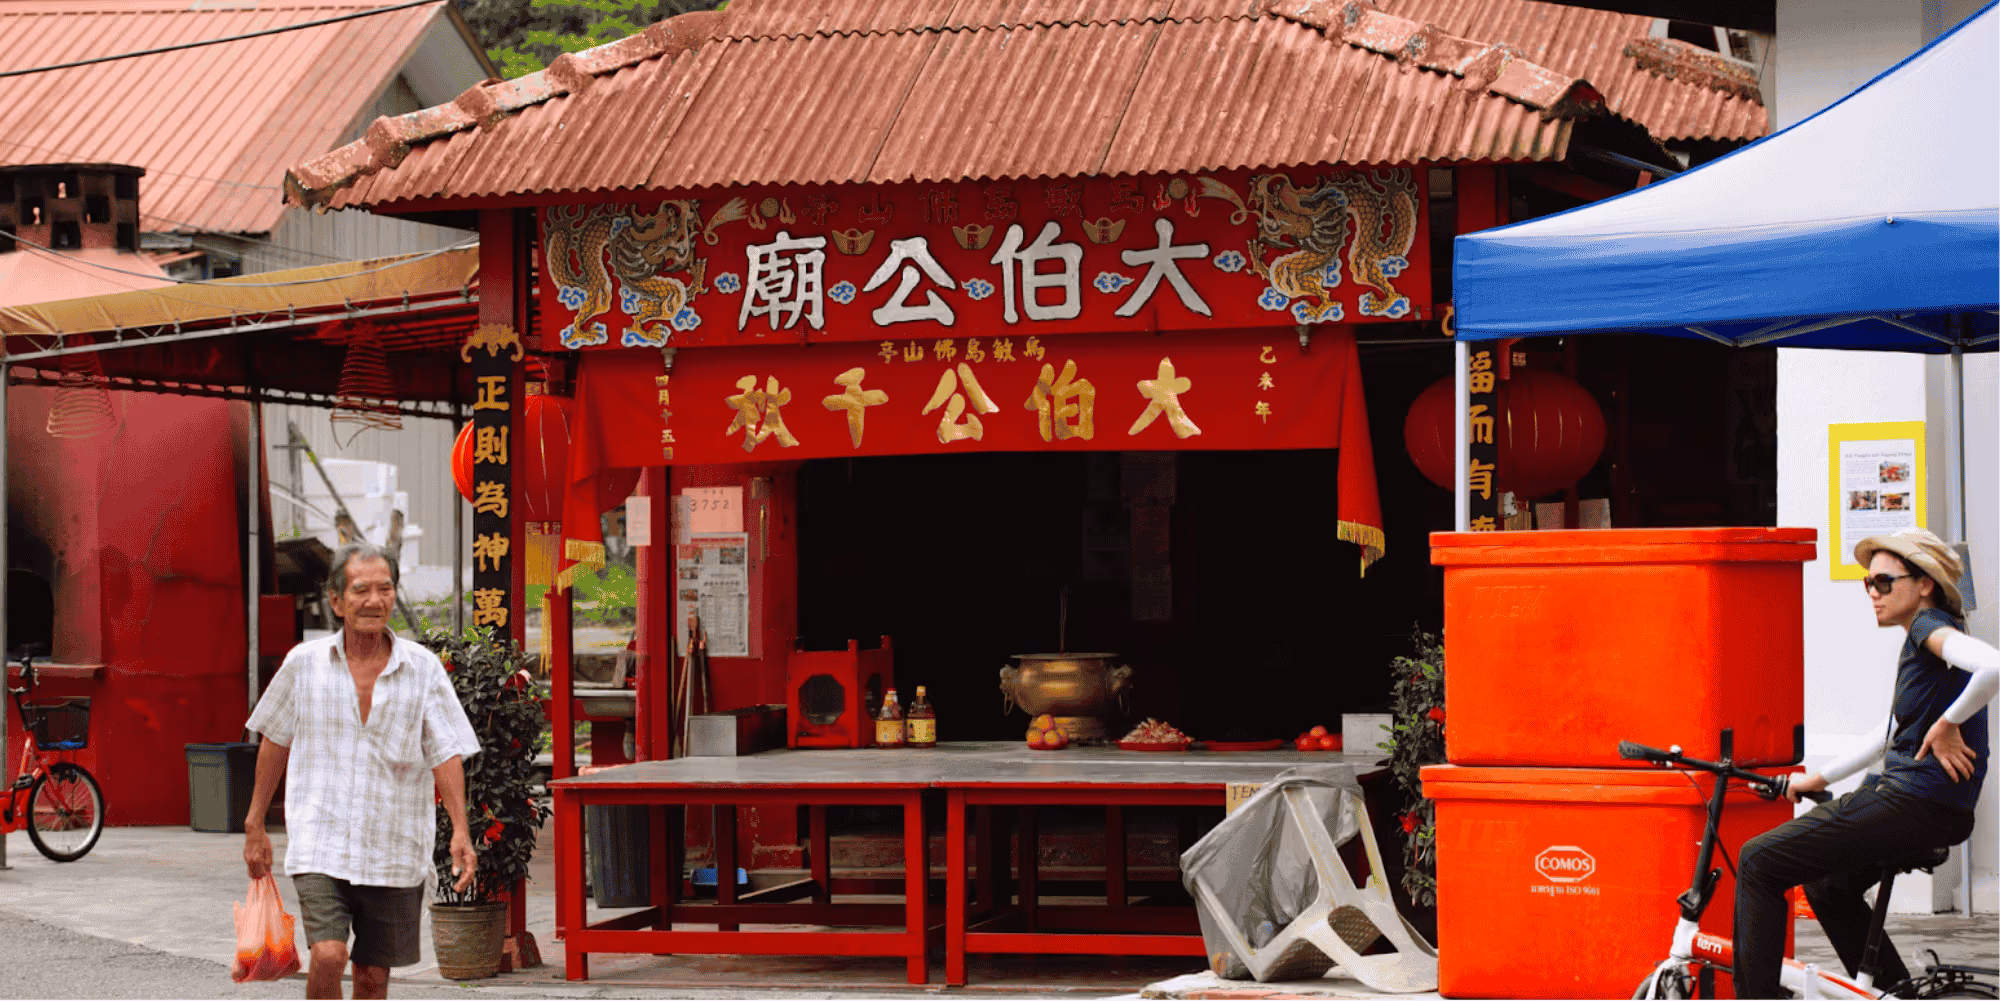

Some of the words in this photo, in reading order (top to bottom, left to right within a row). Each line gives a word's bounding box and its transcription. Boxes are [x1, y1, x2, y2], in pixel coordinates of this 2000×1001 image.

[738, 217, 1212, 331] 大伯公廟
[724, 357, 1202, 453] 大伯公千秋
[1539, 856, 1591, 872] COMOS
[1696, 937, 1722, 955] tern
